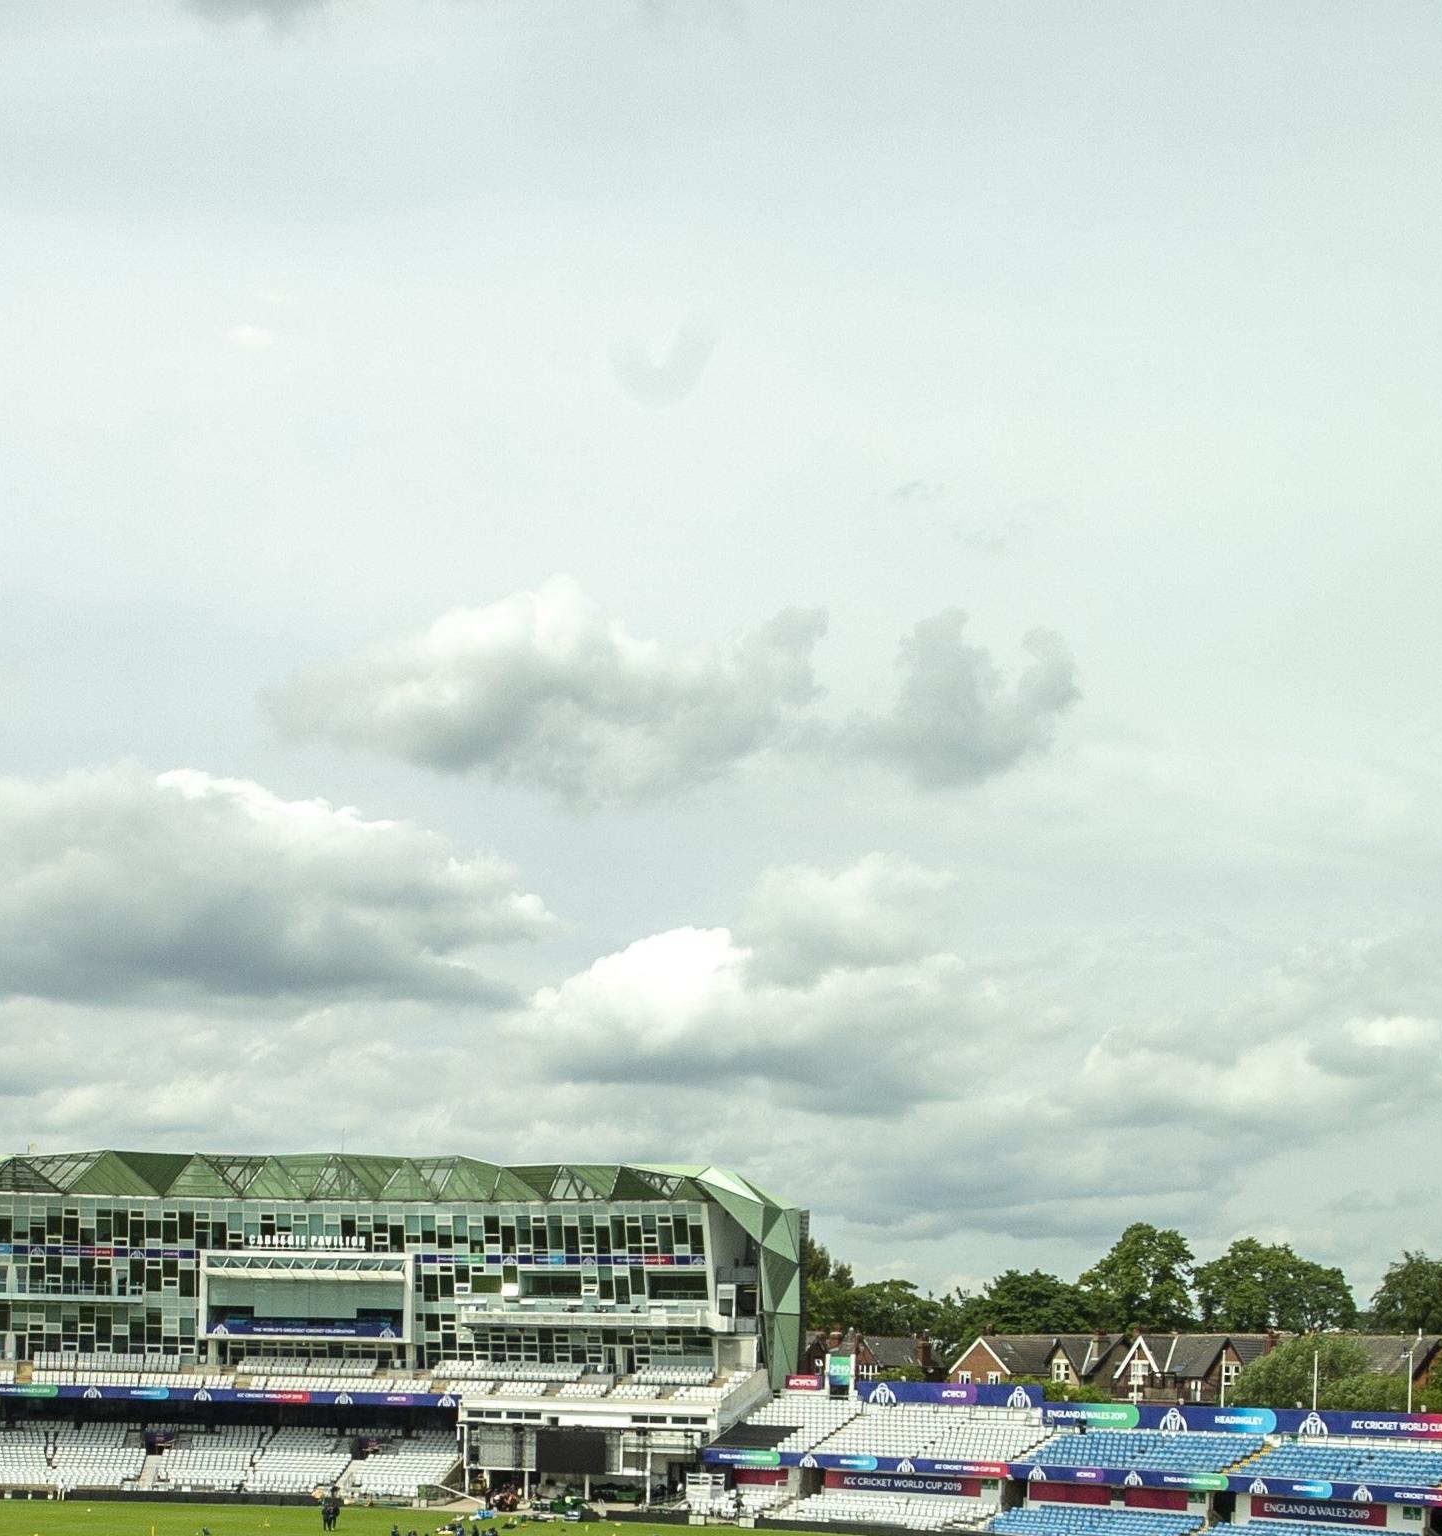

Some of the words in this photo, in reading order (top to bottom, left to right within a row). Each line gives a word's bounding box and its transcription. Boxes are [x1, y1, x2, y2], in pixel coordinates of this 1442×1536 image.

[249, 1234, 306, 1247] CARNEGIE
[311, 1235, 366, 1248] PAVILION
[1215, 1416, 1263, 1425] HEADINGLEY
[1351, 1421, 1364, 1429] ICC
[1365, 1421, 1398, 1430] CRICKET
[1399, 1423, 1428, 1431] WORLD
[843, 1477, 856, 1485] ICC
[858, 1477, 892, 1487] CRICKET
[894, 1479, 923, 1489] WORLD
[926, 1480, 942, 1490] CUP
[944, 1481, 962, 1491] 2019
[1263, 1503, 1307, 1514] ENGLAND
[1317, 1507, 1347, 1518] WALES
[1349, 1509, 1370, 1519] 2019
